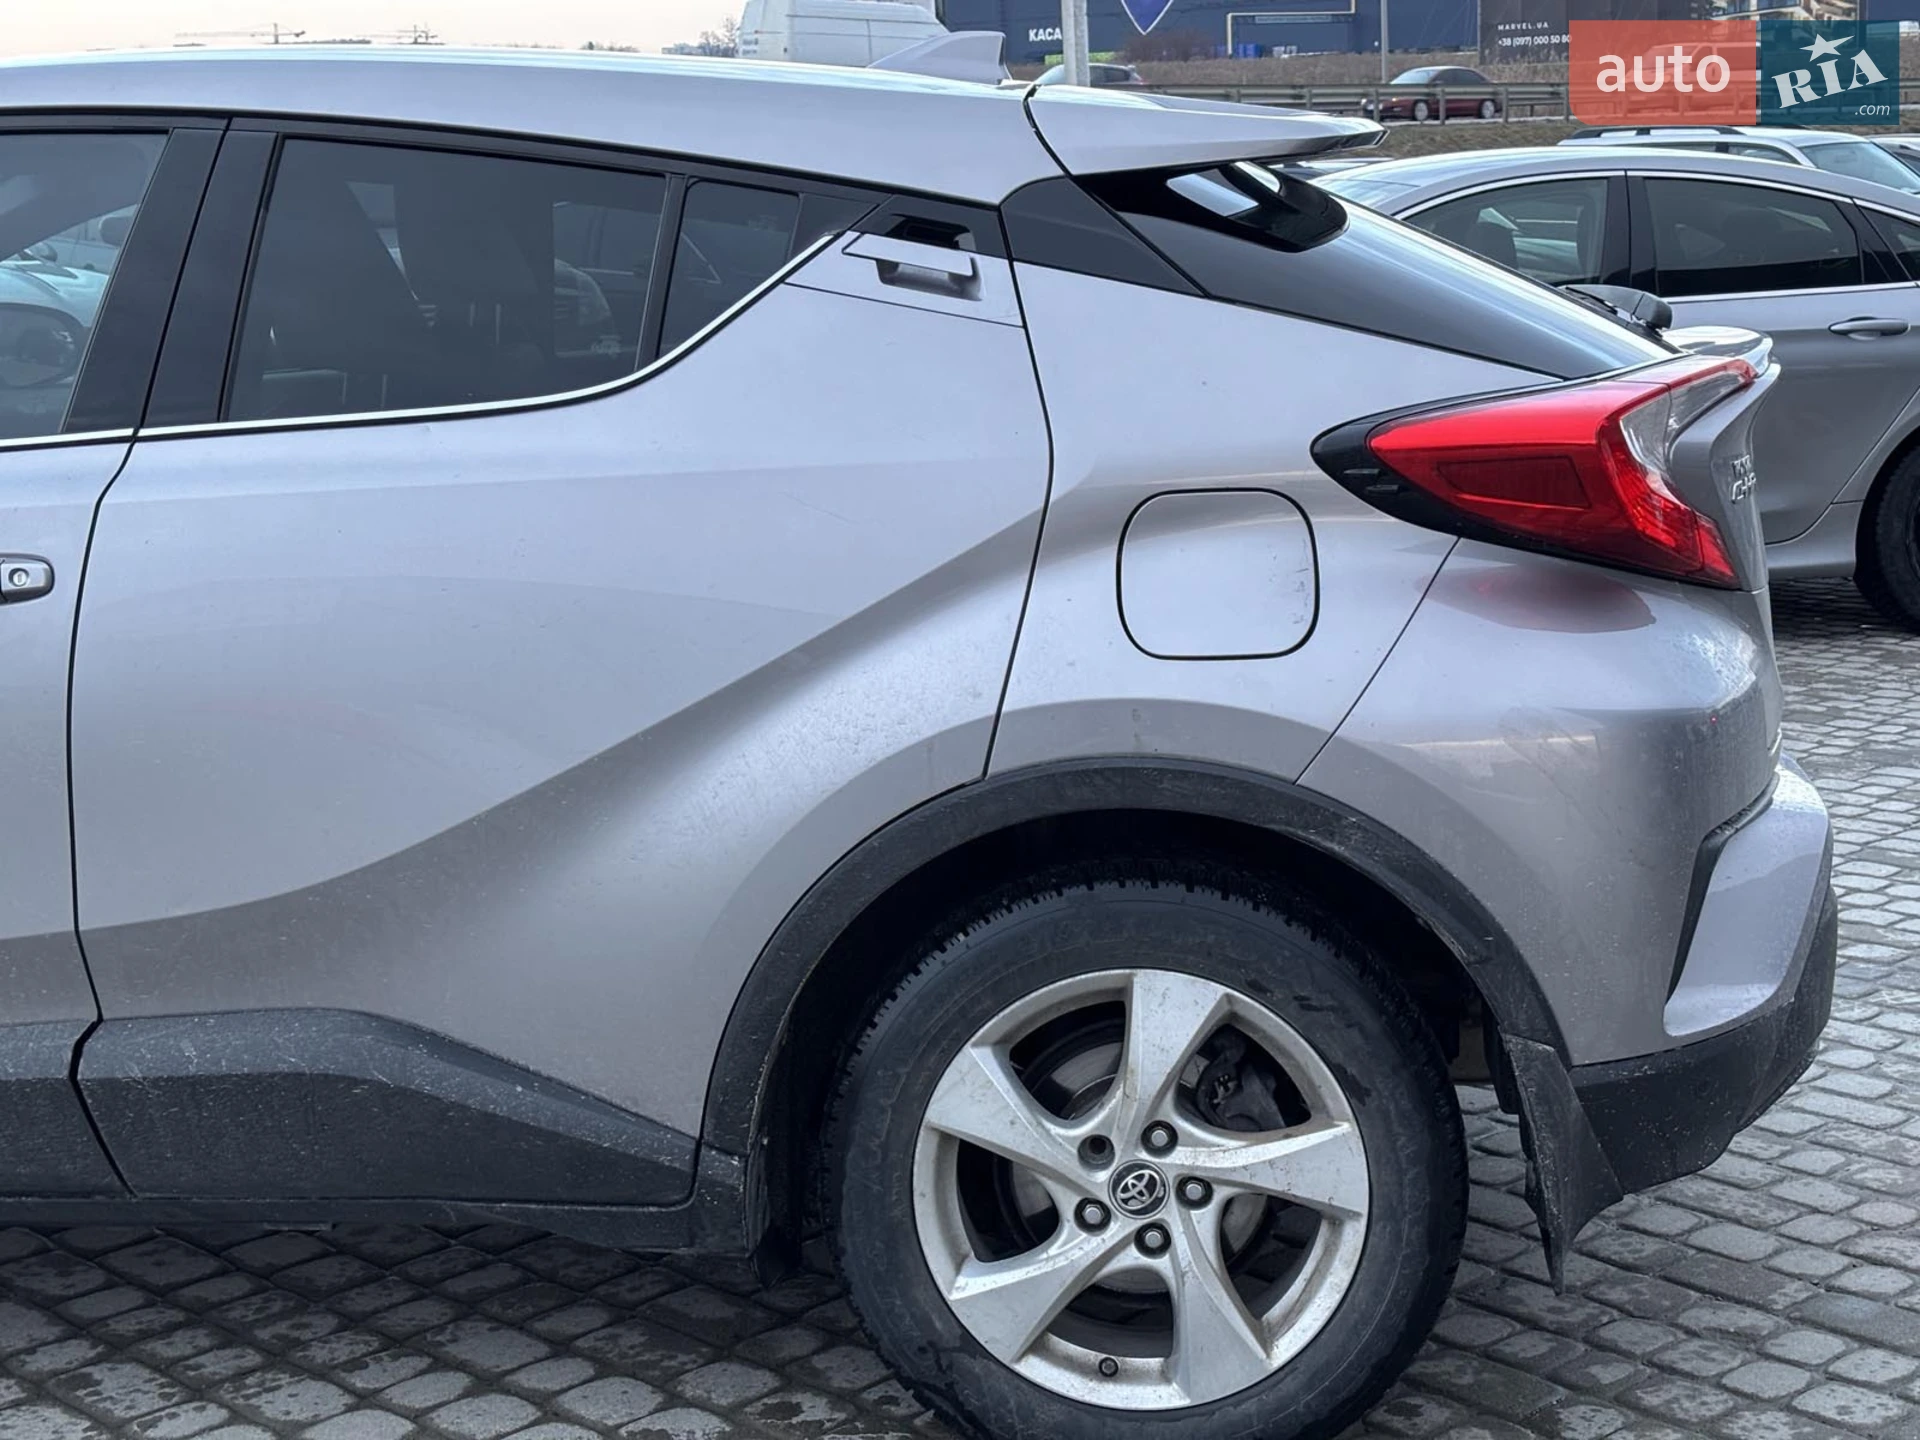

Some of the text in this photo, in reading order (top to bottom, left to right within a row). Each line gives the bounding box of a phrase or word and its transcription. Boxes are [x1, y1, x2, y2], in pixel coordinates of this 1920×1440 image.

[1498, 22, 1548, 30] MARVEL.UA
[1533, 36, 1549, 44] 000
[1550, 35, 1560, 43] 50
